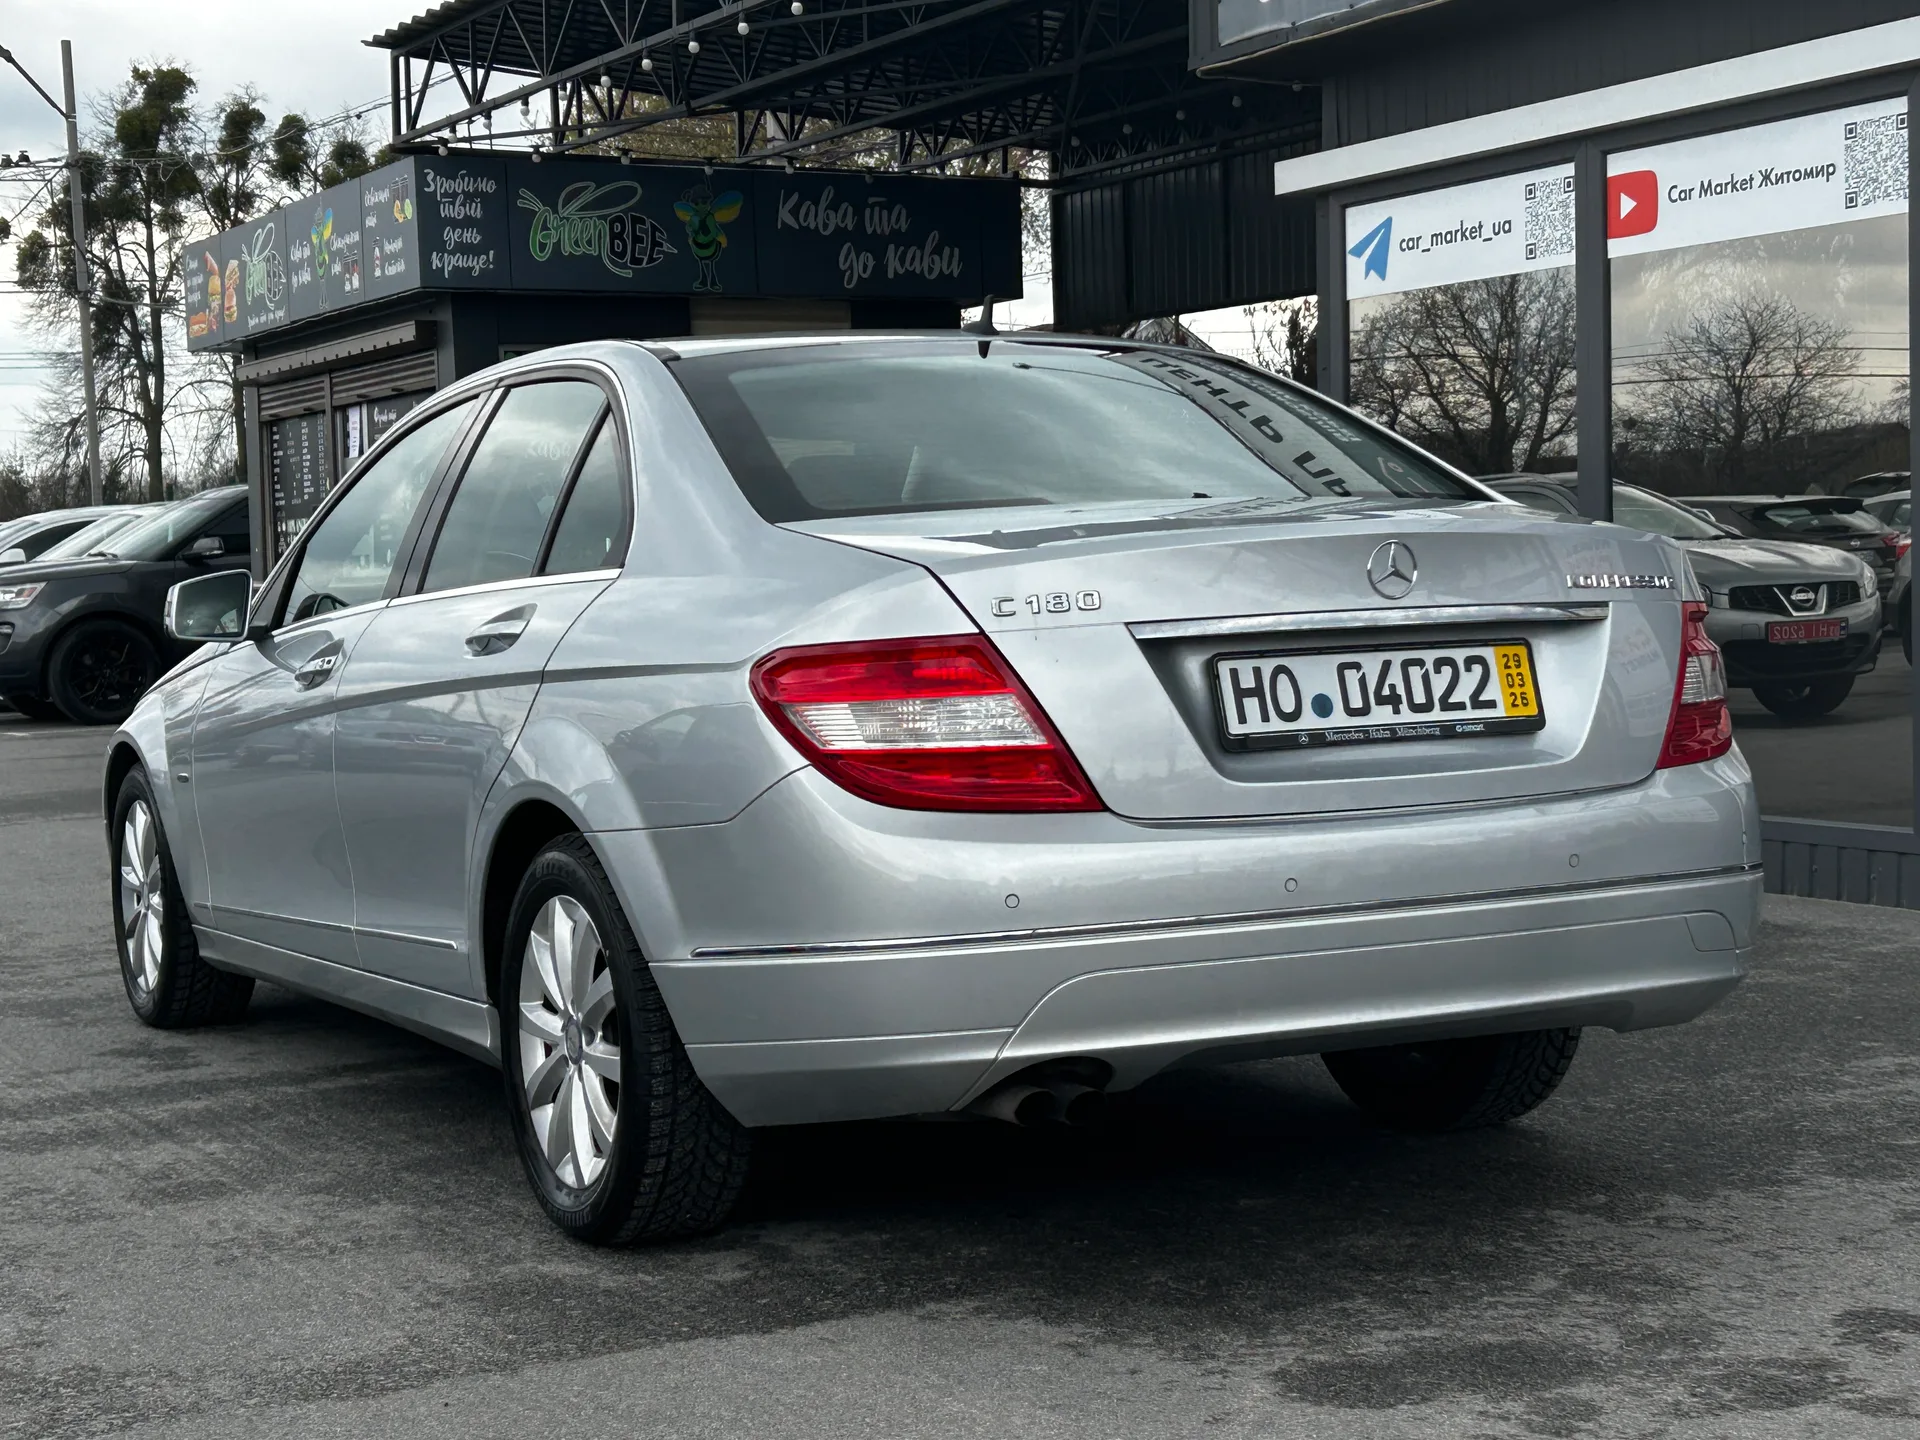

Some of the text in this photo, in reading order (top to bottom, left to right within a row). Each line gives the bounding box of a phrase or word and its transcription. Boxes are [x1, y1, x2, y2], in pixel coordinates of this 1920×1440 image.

[423, 168, 497, 202] Зробимо
[1667, 162, 1837, 204] Car Market Житомир
[438, 197, 483, 219] твій
[777, 185, 911, 236] Кава та
[443, 226, 482, 249] день
[1399, 213, 1513, 253] car_market_ua
[431, 250, 495, 278] краще!
[838, 230, 963, 289] до кави
[991, 590, 1101, 617] C 180
[1501, 653, 1522, 670] 29
[1229, 654, 1498, 725] HO 04022
[1505, 671, 1526, 688] 03
